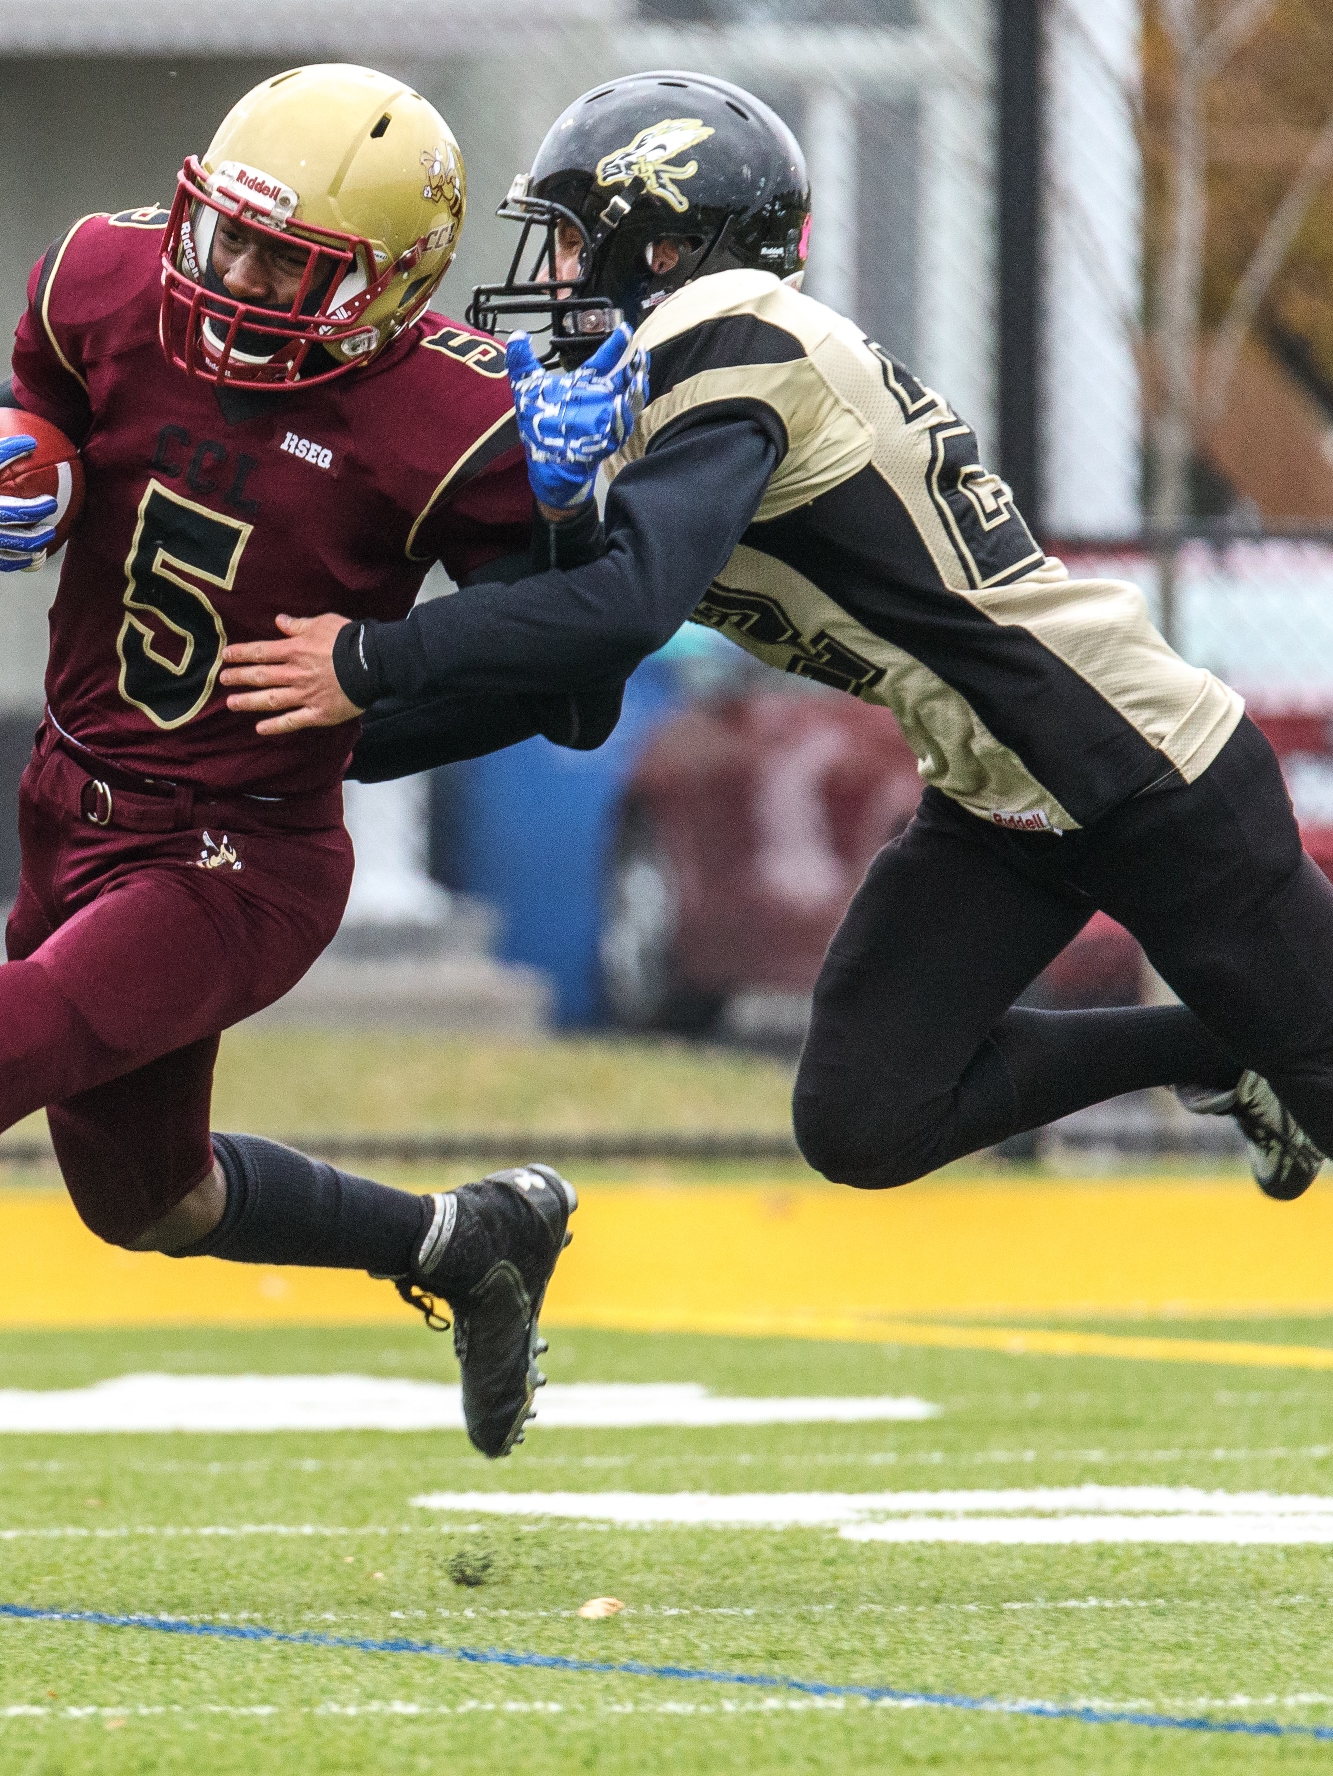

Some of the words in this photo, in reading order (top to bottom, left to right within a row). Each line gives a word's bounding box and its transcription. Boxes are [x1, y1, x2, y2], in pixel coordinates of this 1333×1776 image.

[236, 169, 282, 200] Riddell
[181, 221, 199, 278] Riddell
[420, 327, 510, 379] 5
[151, 423, 260, 516] CCL
[280, 431, 333, 469] RSEQ
[117, 477, 254, 730] 5
